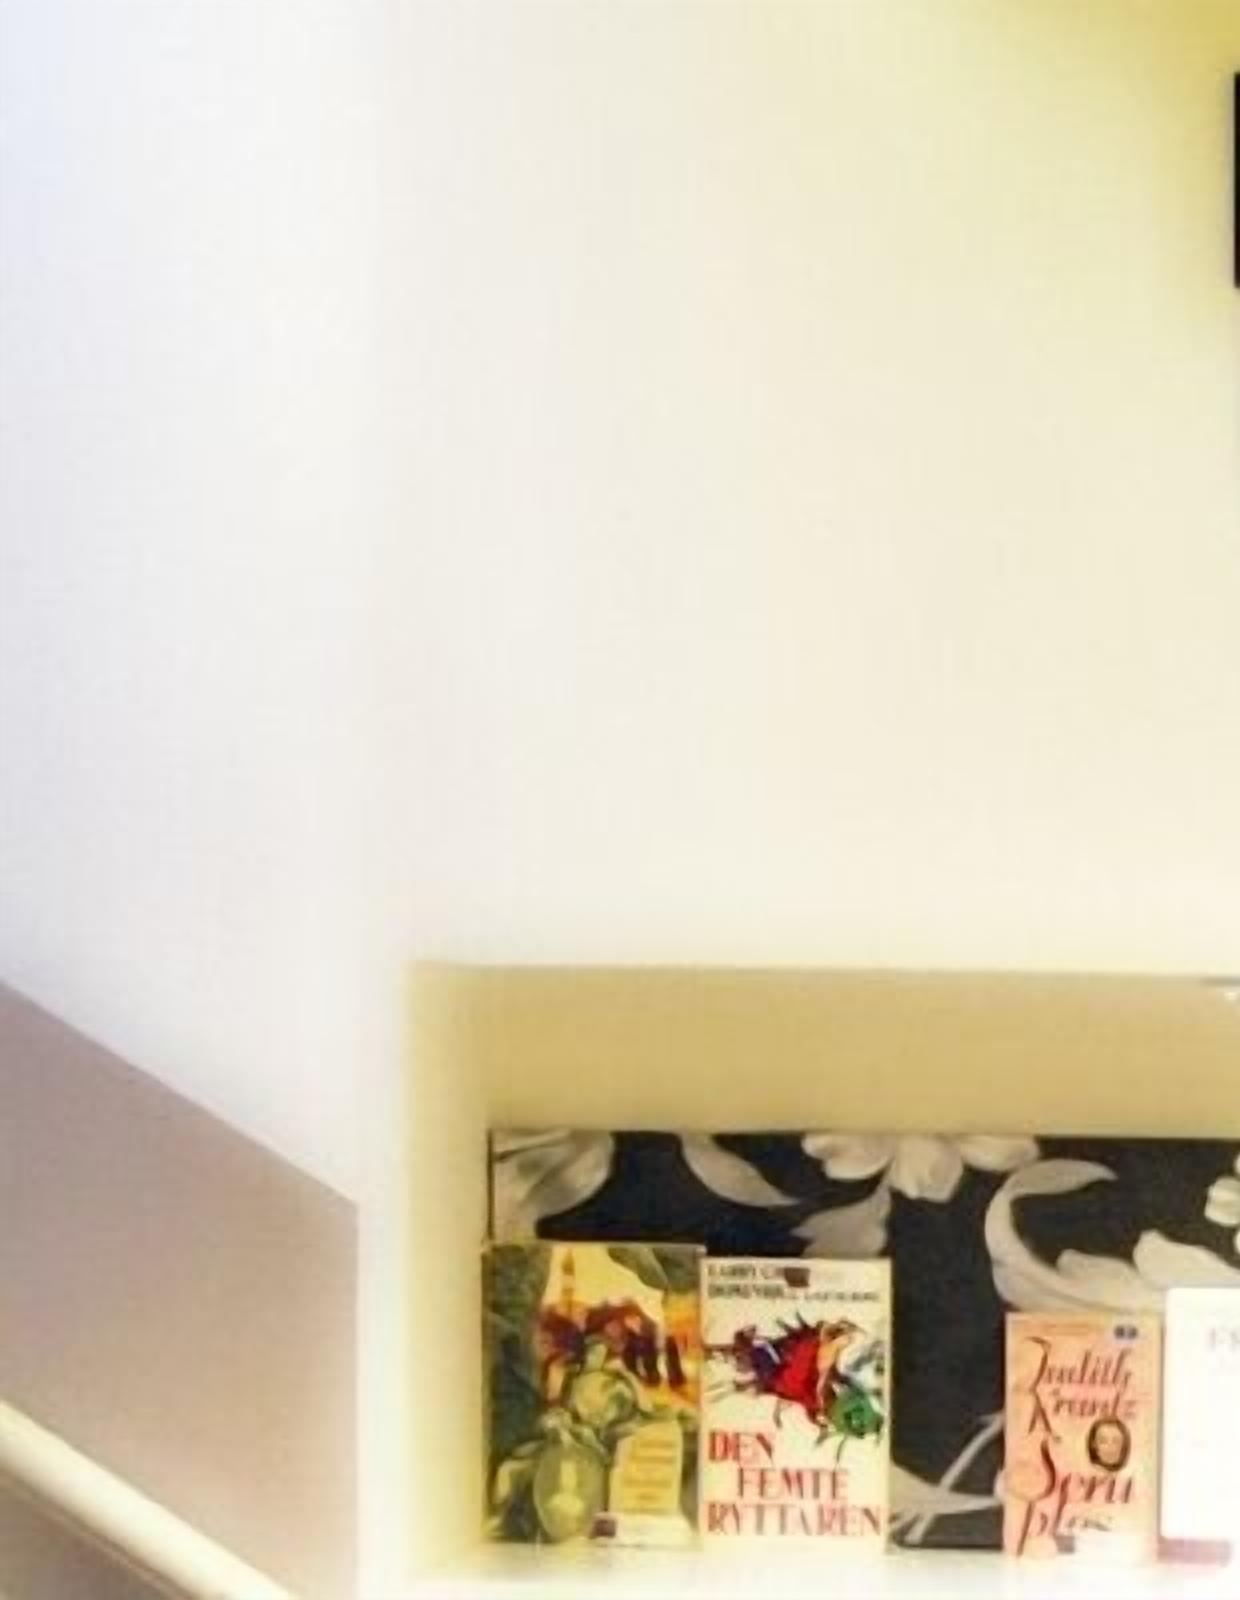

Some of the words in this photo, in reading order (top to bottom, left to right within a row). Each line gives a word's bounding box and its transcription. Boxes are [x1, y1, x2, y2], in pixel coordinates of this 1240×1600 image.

[708, 1432, 776, 1465] DEN
[738, 1468, 850, 1500] FEMTE
[708, 1502, 882, 1537] RYTTAREN
